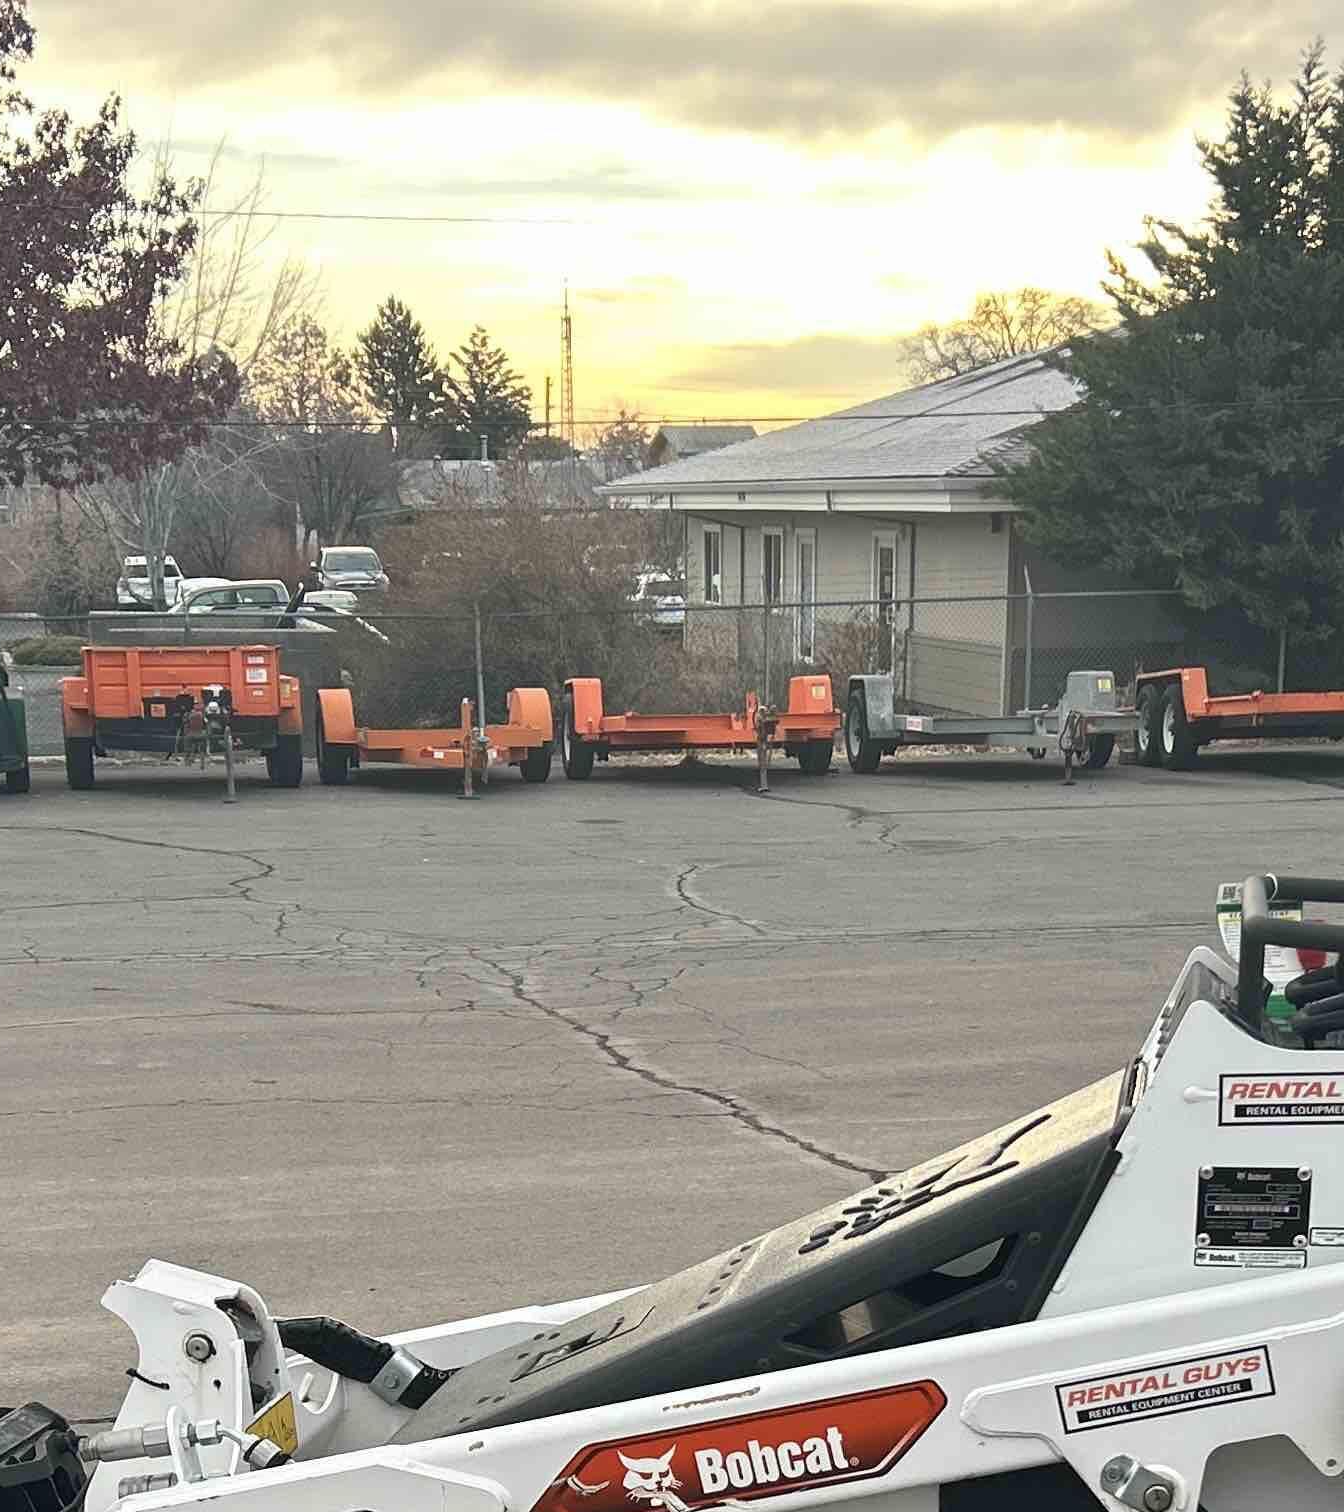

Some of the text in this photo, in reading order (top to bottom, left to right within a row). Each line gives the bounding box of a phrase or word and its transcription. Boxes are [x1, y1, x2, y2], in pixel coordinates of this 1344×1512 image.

[1227, 1080, 1340, 1099] RENTAL
[1246, 1106, 1289, 1116] RENTAL
[1067, 1355, 1262, 1408] RENTAL GUYS
[1088, 1382, 1242, 1420] RENTAL EQUIPMENT CENTER
[693, 1426, 849, 1495] Bobcat
